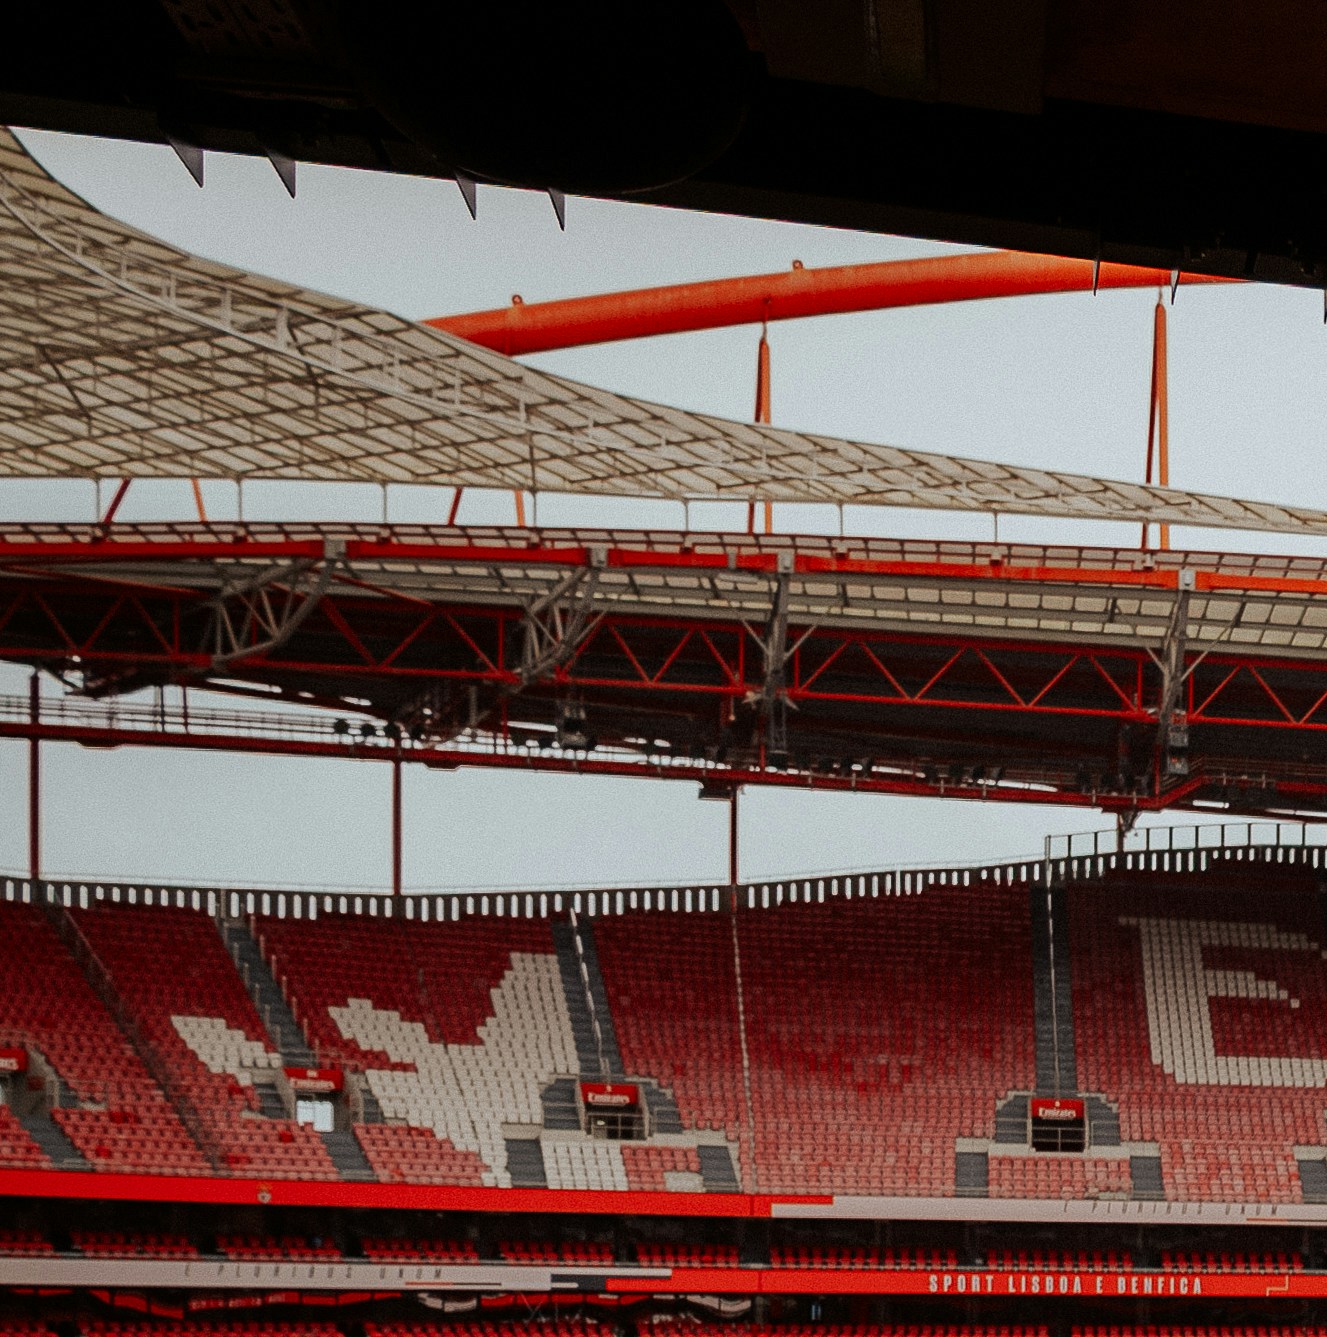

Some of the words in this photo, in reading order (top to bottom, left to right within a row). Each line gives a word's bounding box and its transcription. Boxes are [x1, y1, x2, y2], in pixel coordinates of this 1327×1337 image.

[928, 1274, 995, 1293] SPORT
[1007, 1274, 1082, 1294] LISBOA
[1095, 1276, 1104, 1294] E
[1117, 1276, 1202, 1295] BENFICA
